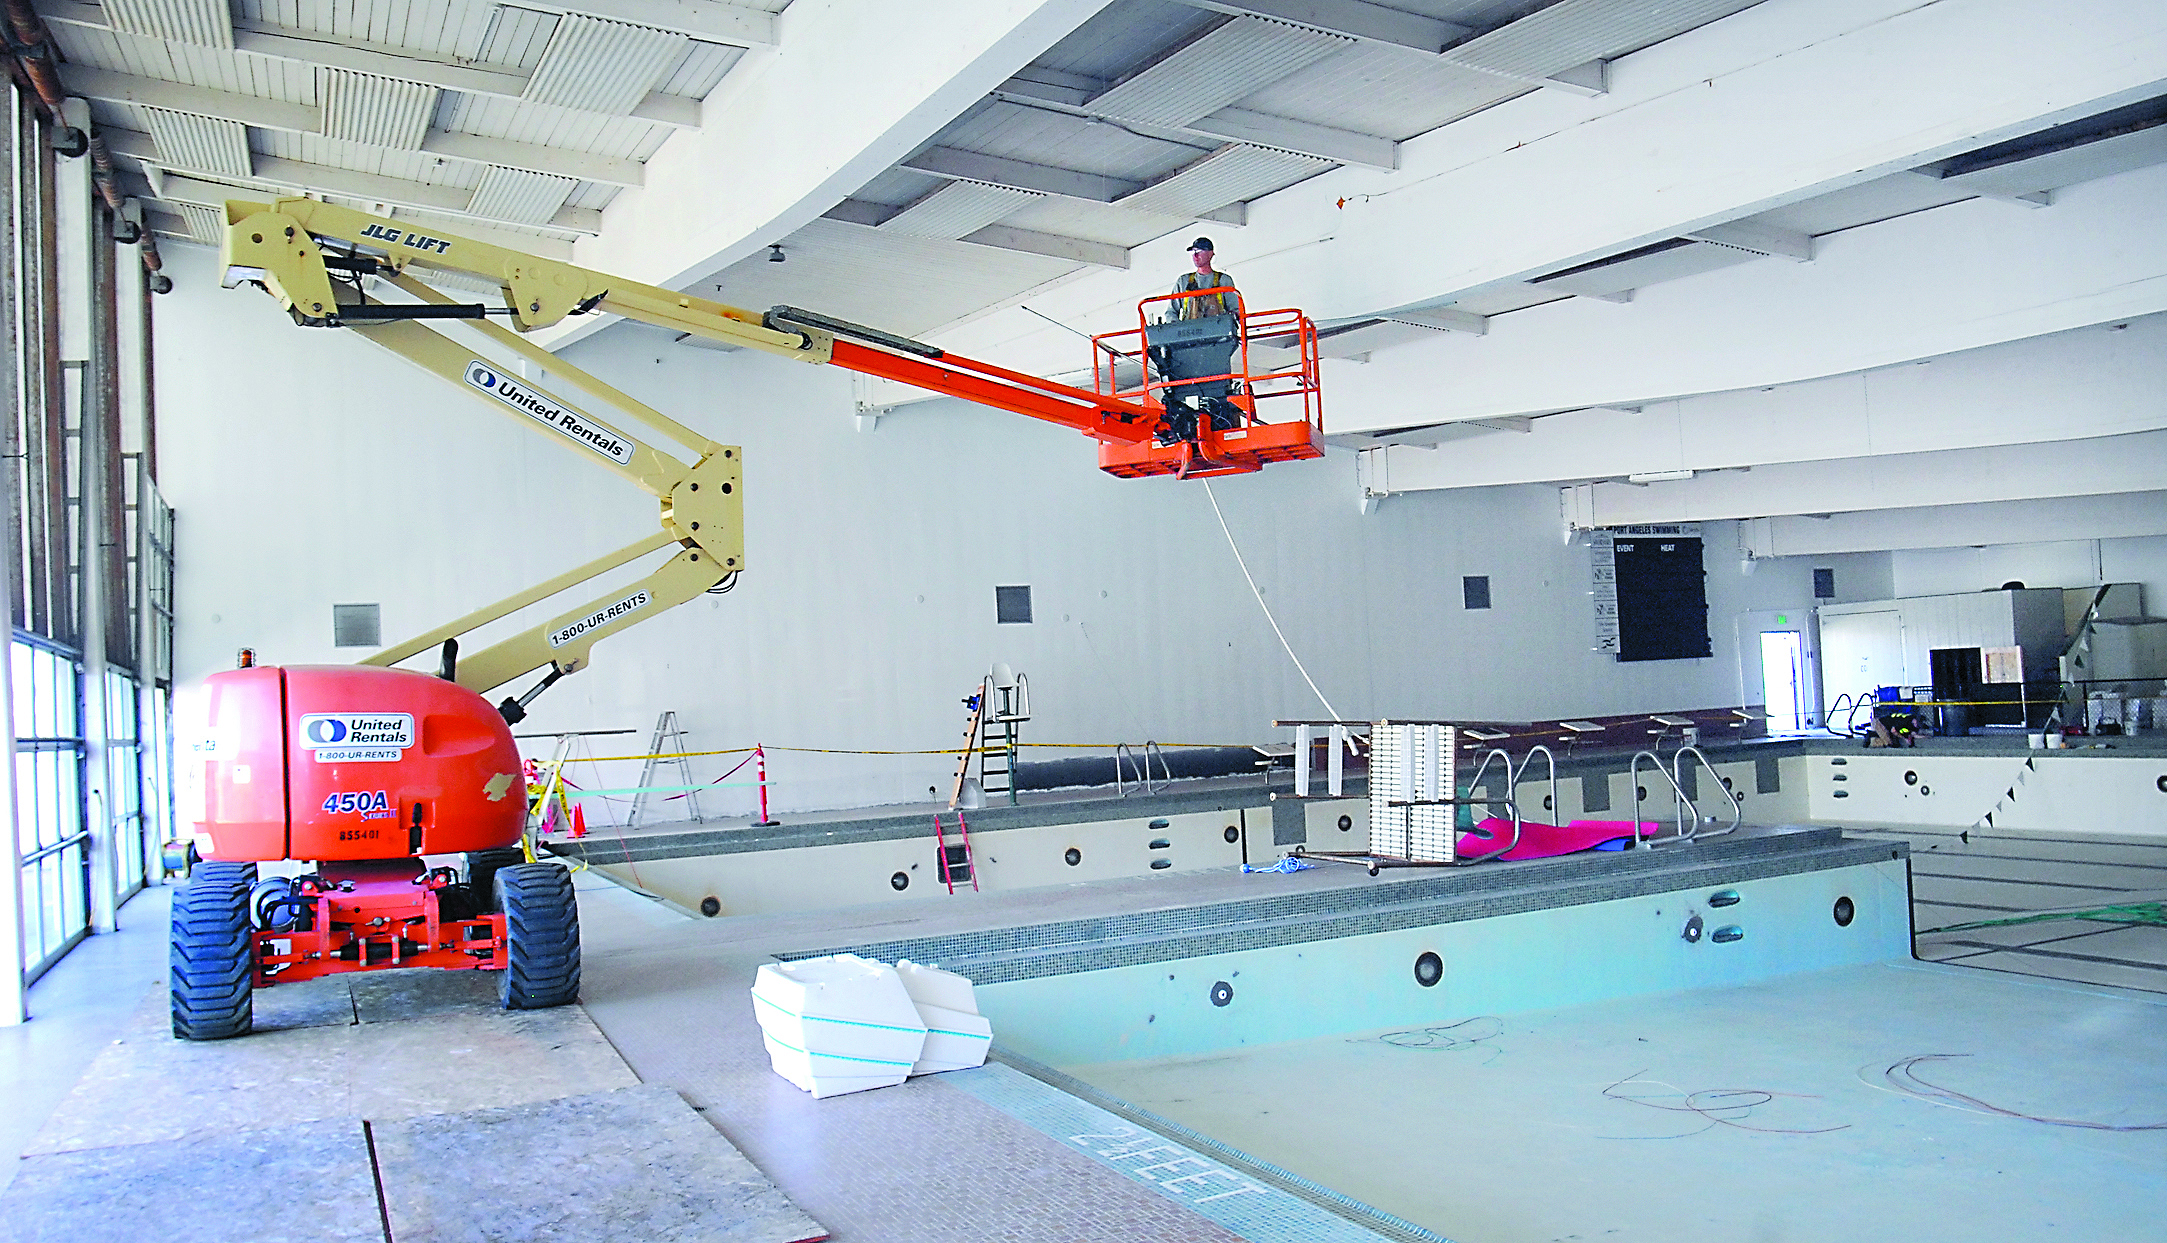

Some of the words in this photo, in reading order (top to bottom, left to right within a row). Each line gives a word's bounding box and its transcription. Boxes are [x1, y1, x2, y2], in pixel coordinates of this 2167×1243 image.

[360, 224, 402, 242] JLG
[403, 233, 452, 254] LIFT
[498, 382, 560, 422] United
[559, 415, 624, 456] Rentals
[1613, 525, 1627, 534] PORT
[1628, 525, 1651, 534] ANGELES
[1652, 525, 1680, 534] SWIMMING
[1616, 544, 1635, 552] EVENT
[1660, 544, 1675, 552] HEAT
[552, 593, 646, 644] 1-800-UR-RENTS
[351, 719, 402, 730] United
[350, 731, 407, 742] Rentals
[319, 750, 397, 759] 1-800-UR-RENTS
[323, 791, 389, 814] 450A
[340, 830, 379, 840] 855401
[1110, 1145, 1269, 1203] FEET
